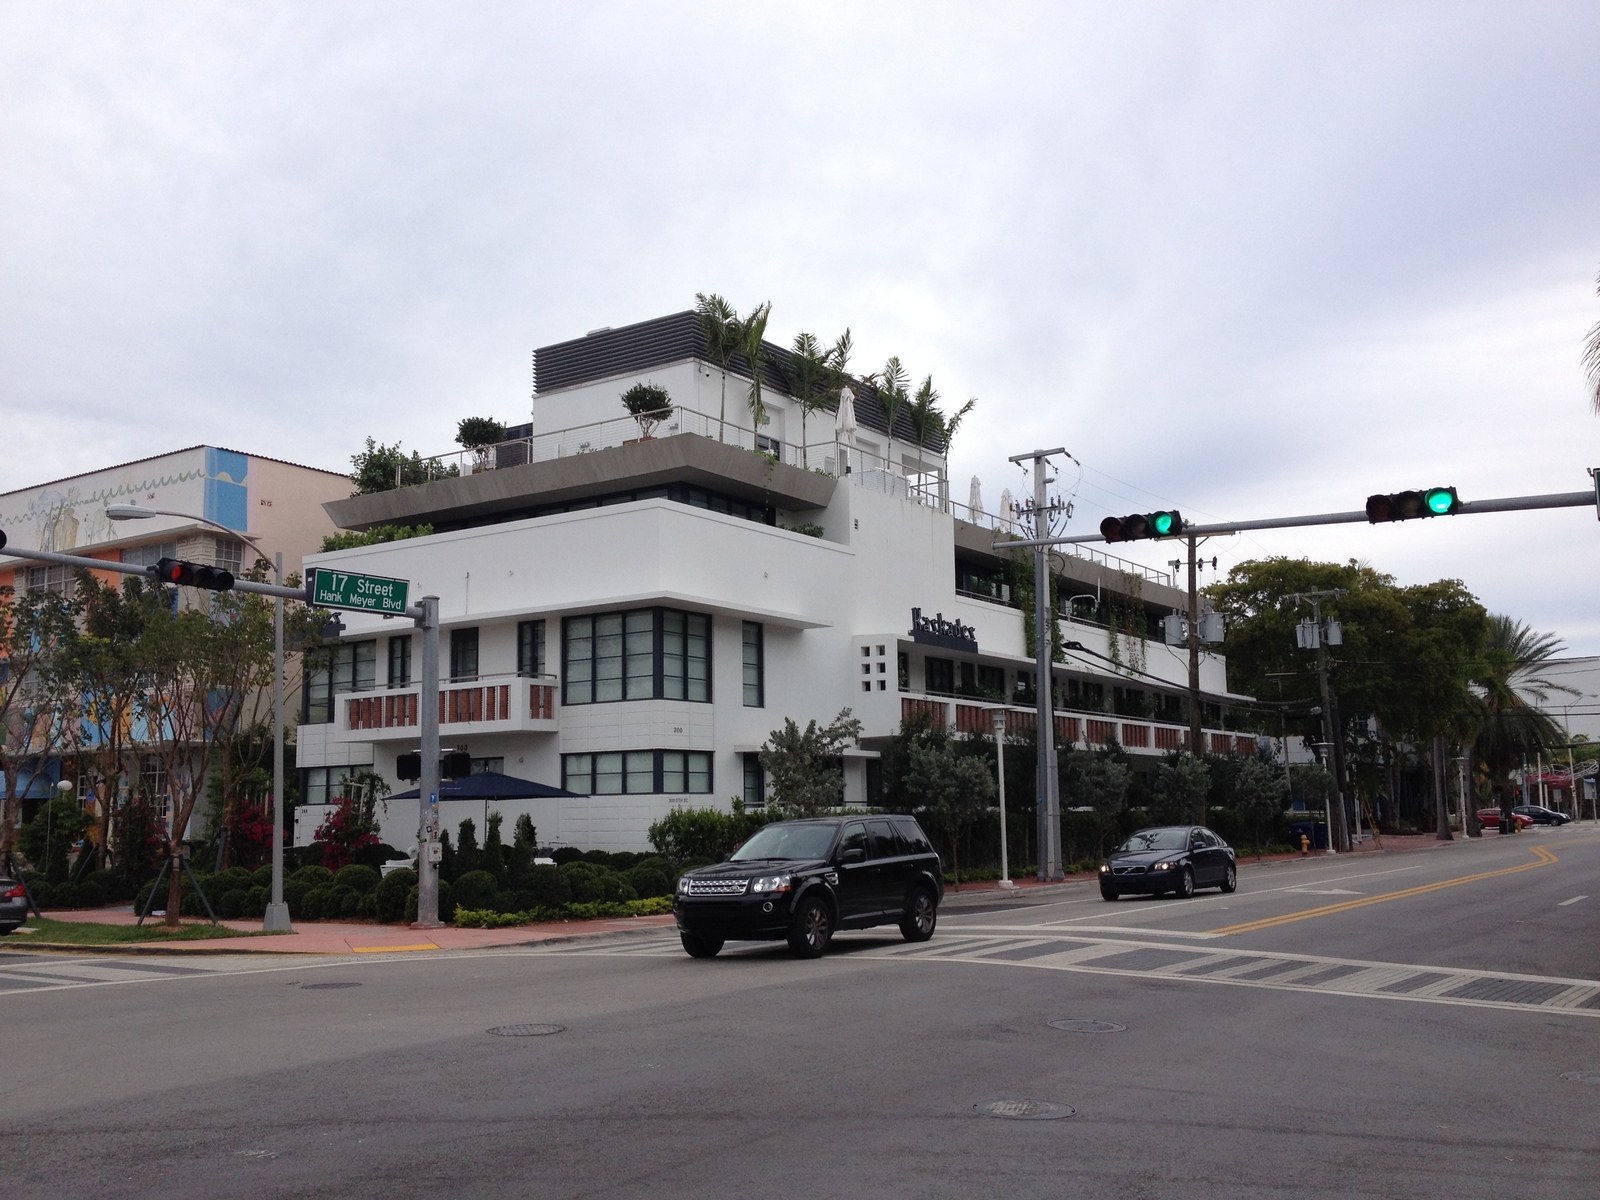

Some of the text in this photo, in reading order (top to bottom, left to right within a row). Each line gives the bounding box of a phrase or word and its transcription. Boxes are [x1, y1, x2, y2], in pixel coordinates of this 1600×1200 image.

[331, 573, 394, 597] 17 Street
[319, 589, 402, 610] Hank Meyer Blvd
